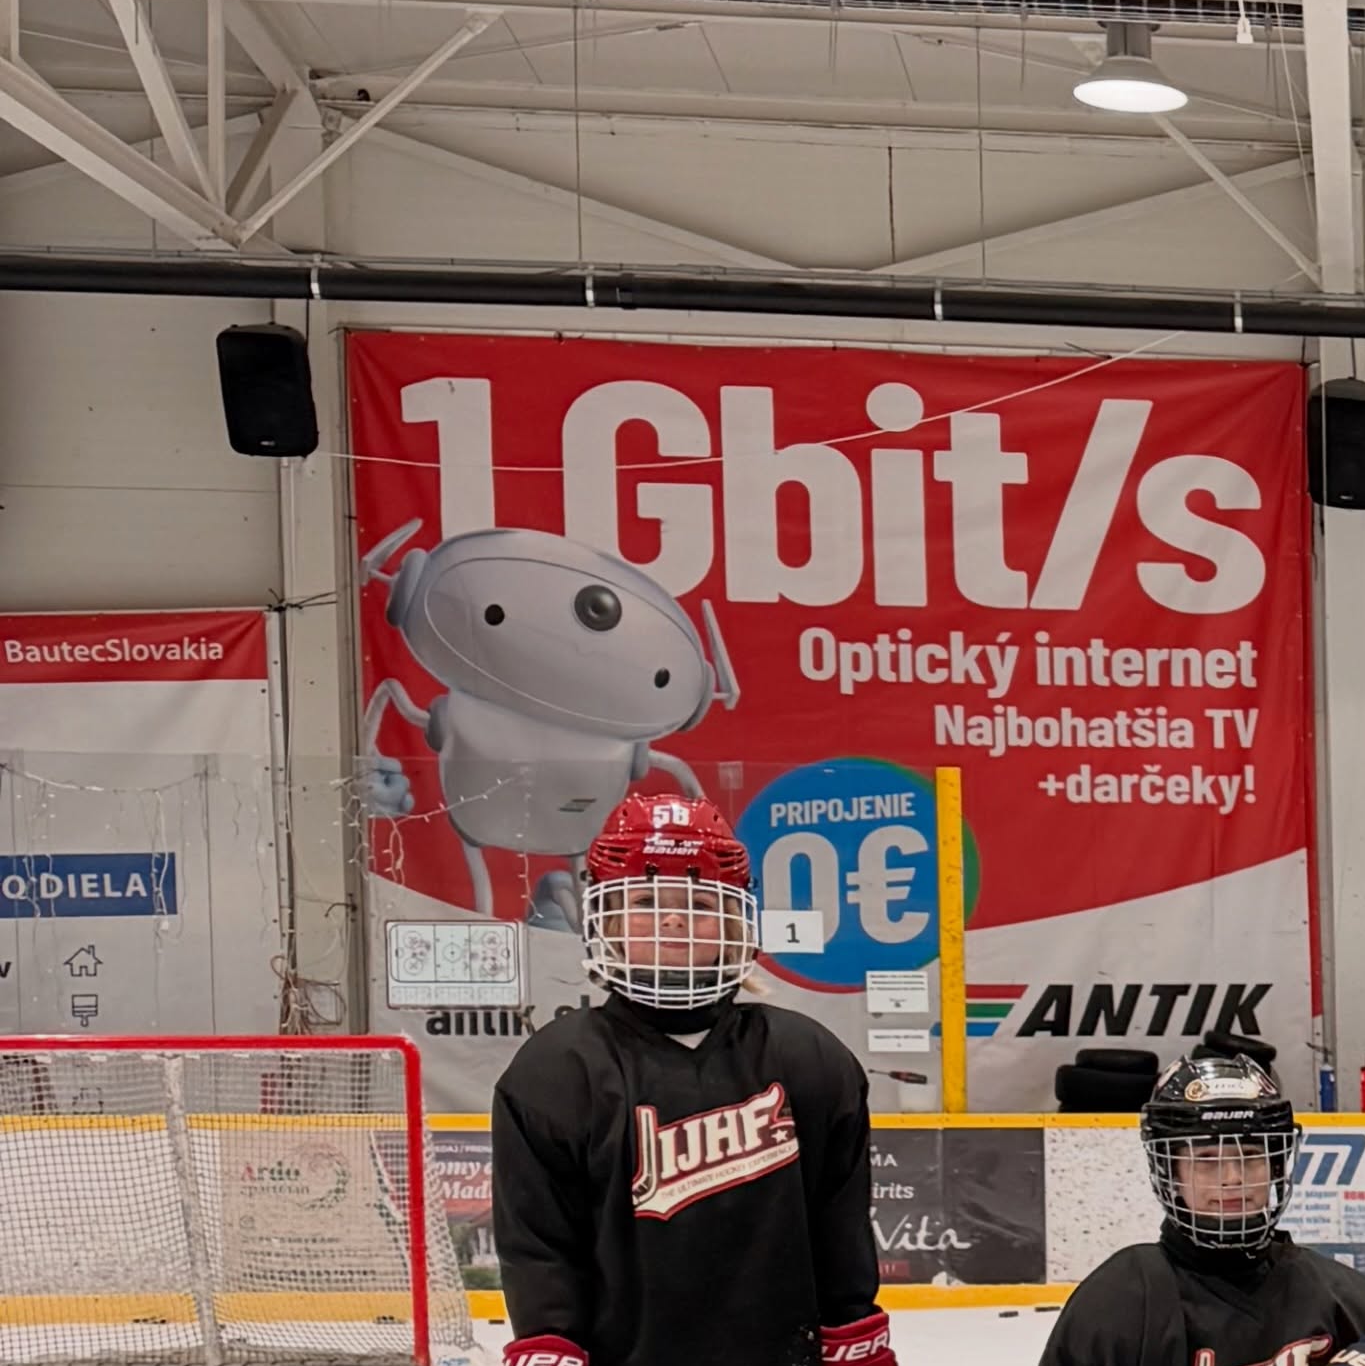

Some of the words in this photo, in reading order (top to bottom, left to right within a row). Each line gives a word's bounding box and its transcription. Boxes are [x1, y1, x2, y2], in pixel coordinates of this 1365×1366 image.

[401, 377, 496, 537] 1
[563, 380, 1266, 615] Gbit/s
[5, 638, 223, 663] BautecSlovakia
[799, 627, 1020, 699] Optický
[1037, 636, 1257, 690] internet
[935, 705, 1195, 757] Najbohatšia
[1205, 708, 1259, 749] TV
[770, 793, 916, 829] PRIPOJENIE
[1038, 764, 1257, 814] +darčeky!
[40, 872, 147, 899] DIELA
[785, 923, 800, 944] 1
[1015, 984, 1273, 1038] ANTIK
[658, 1086, 779, 1179] IJHF
[1201, 1110, 1254, 1121] BAUER
